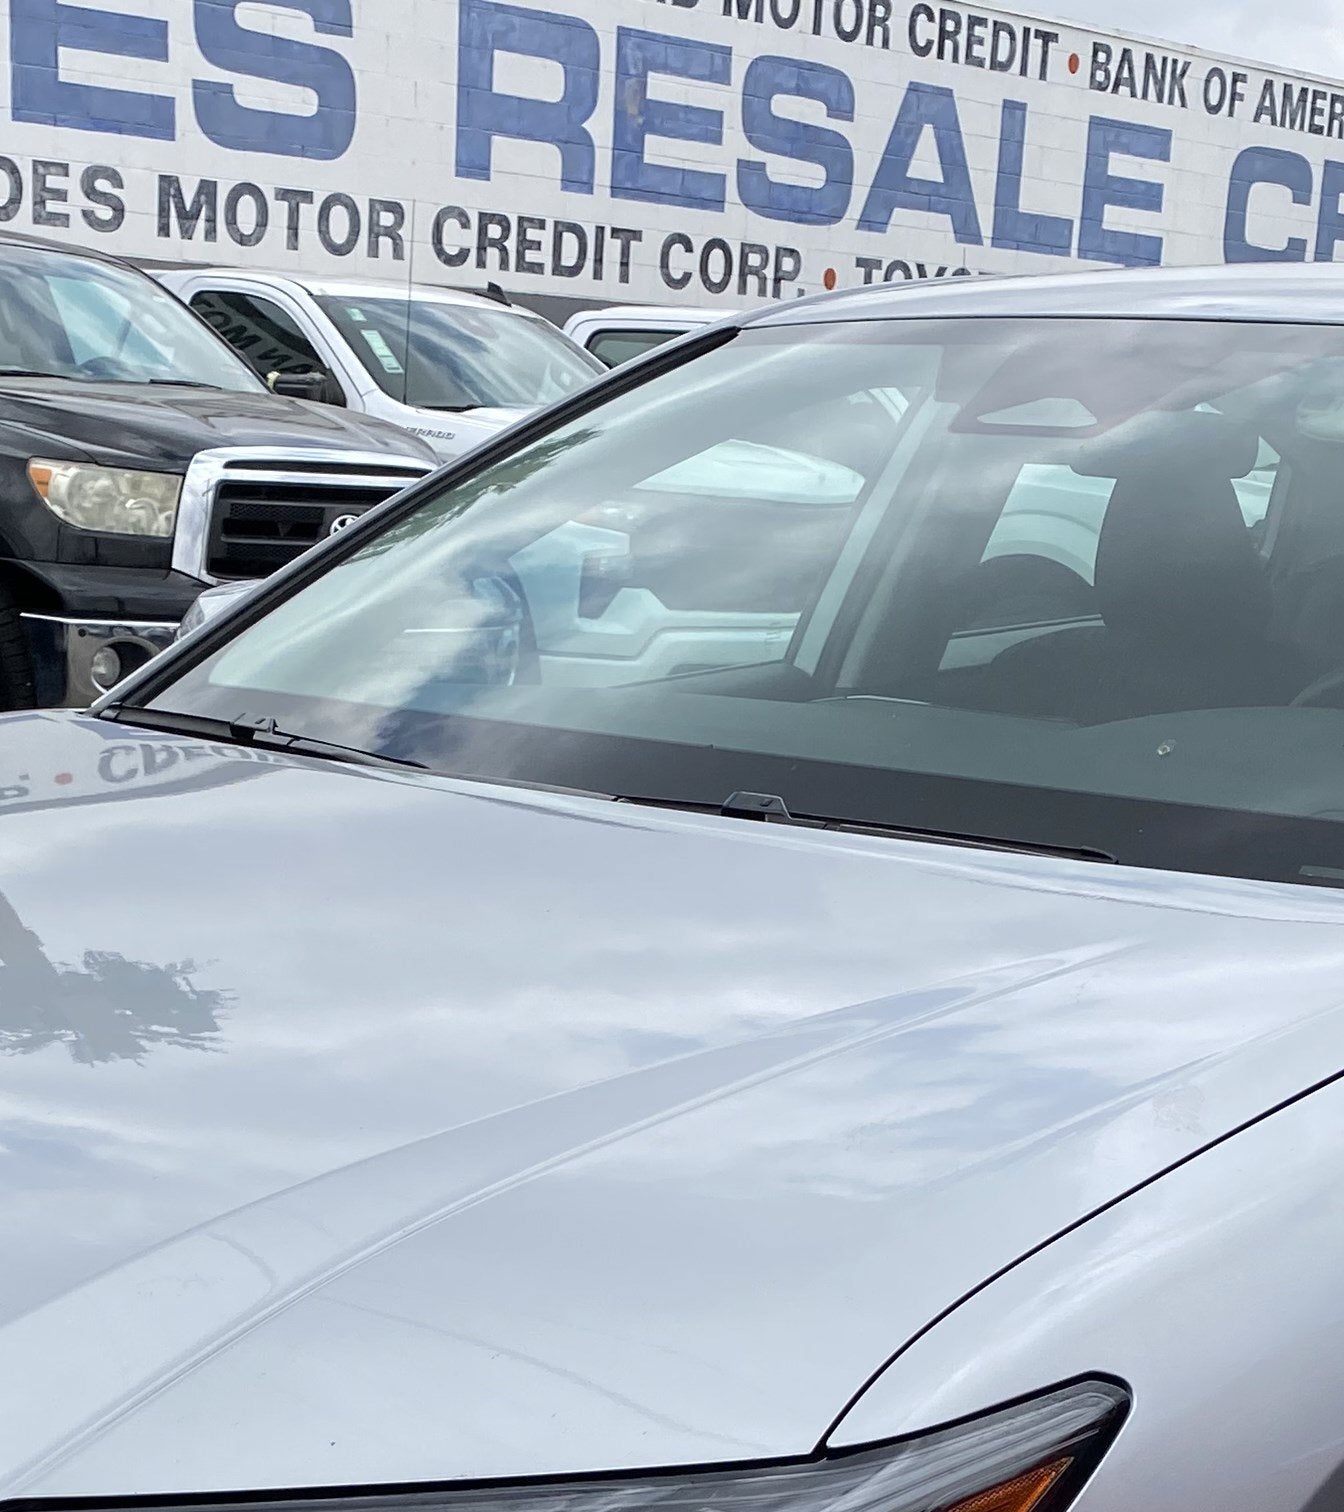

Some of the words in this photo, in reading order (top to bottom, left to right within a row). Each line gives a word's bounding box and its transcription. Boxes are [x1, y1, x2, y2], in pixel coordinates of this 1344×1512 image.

[907, 2, 1059, 82] CREDIT
[1089, 41, 1191, 109] BANK
[1202, 66, 1248, 118] OF
[454, 0, 1173, 268] RESALE
[157, 174, 405, 261] MOTOR
[431, 205, 643, 284] CREDIT
[659, 232, 805, 299] CORP.
